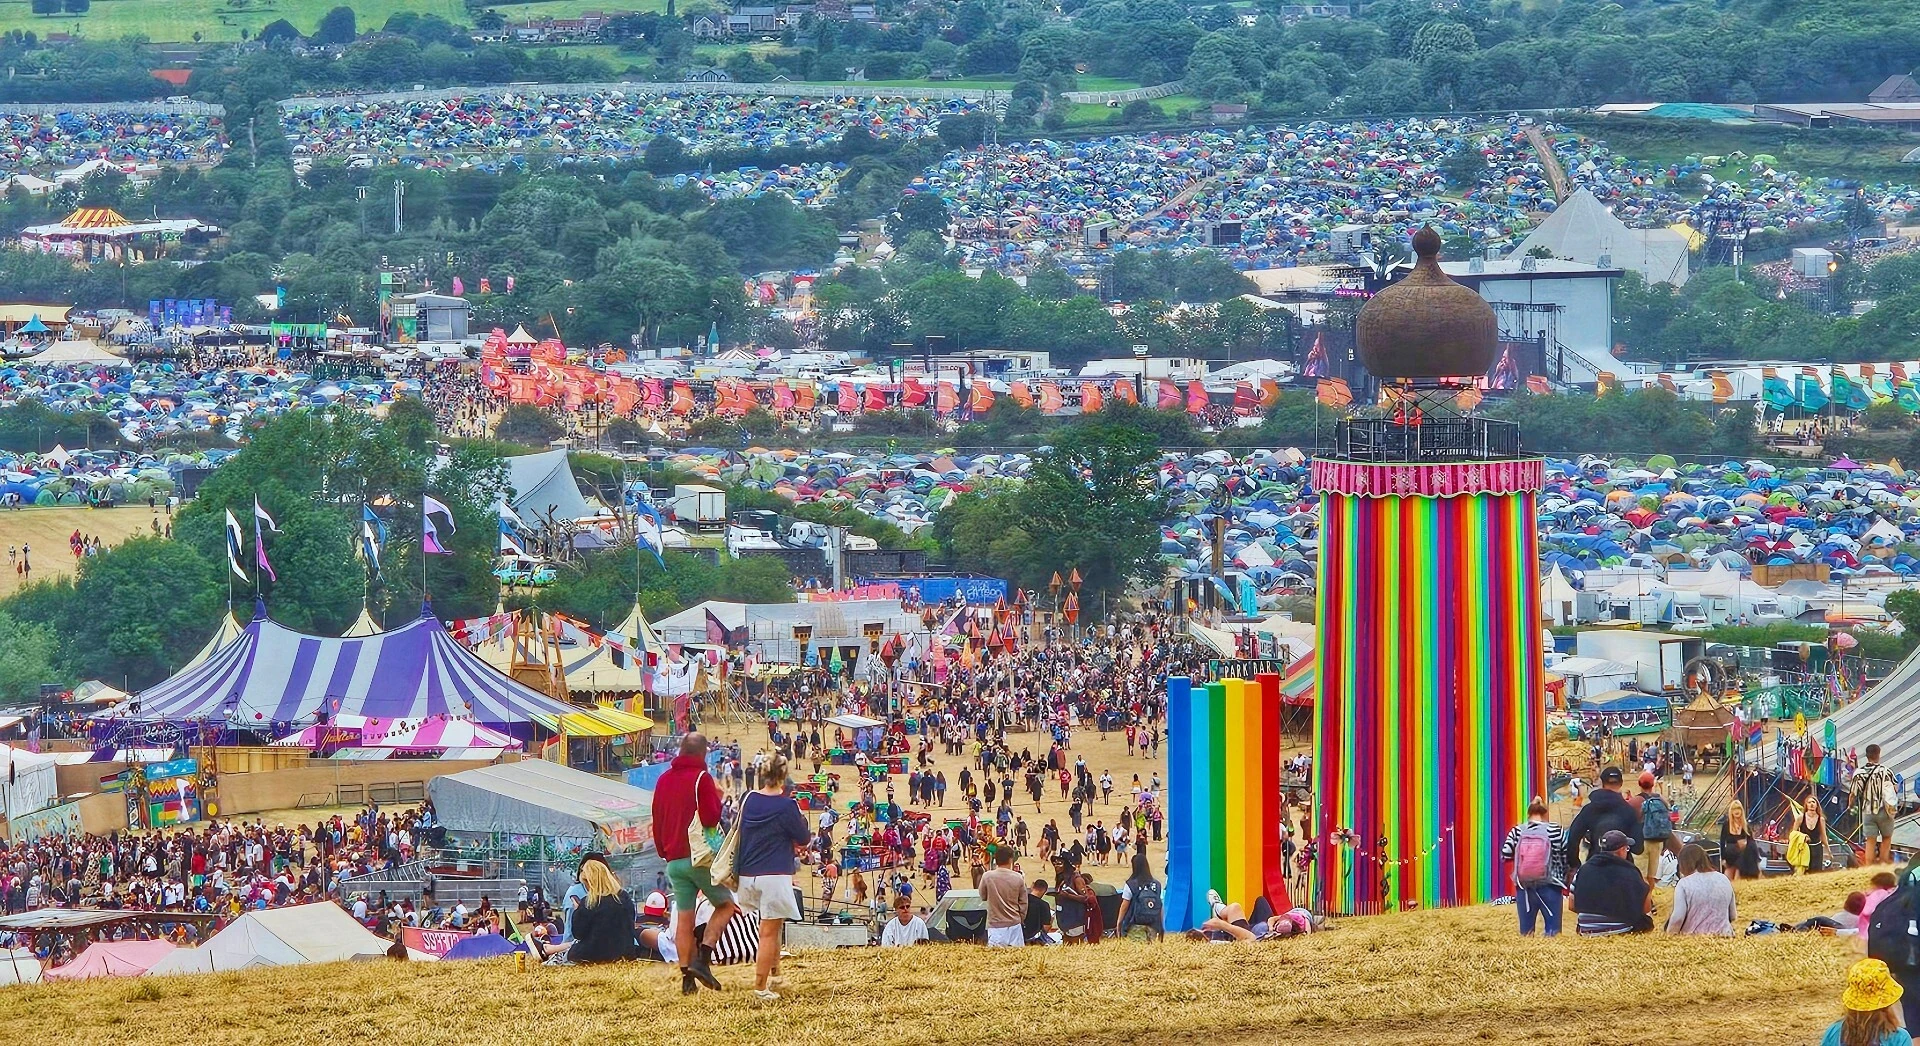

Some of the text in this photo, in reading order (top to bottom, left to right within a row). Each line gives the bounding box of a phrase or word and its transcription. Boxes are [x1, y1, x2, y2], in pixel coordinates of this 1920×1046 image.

[1224, 660, 1272, 678] PARK BAR
[614, 826, 642, 845] THE
